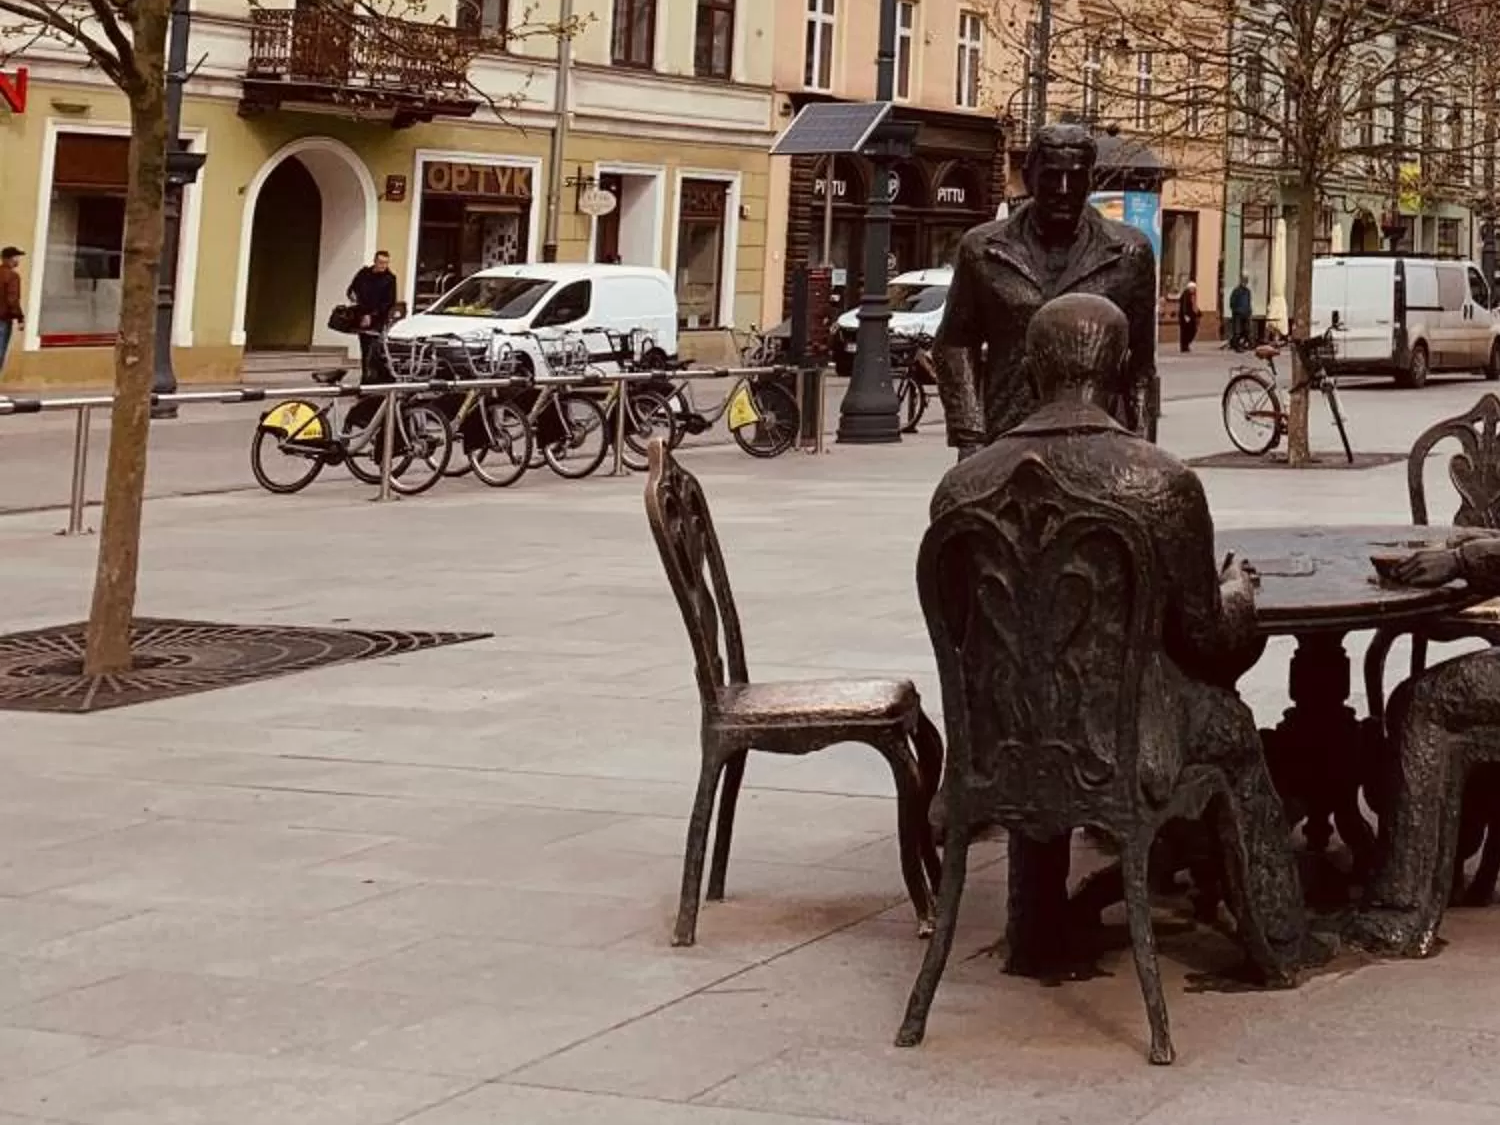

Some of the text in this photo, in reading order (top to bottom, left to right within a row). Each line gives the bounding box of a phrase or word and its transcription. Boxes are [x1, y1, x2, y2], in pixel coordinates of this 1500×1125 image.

[427, 163, 530, 196] OPTYK
[814, 179, 847, 196] PITU
[937, 187, 966, 204] PITTU
